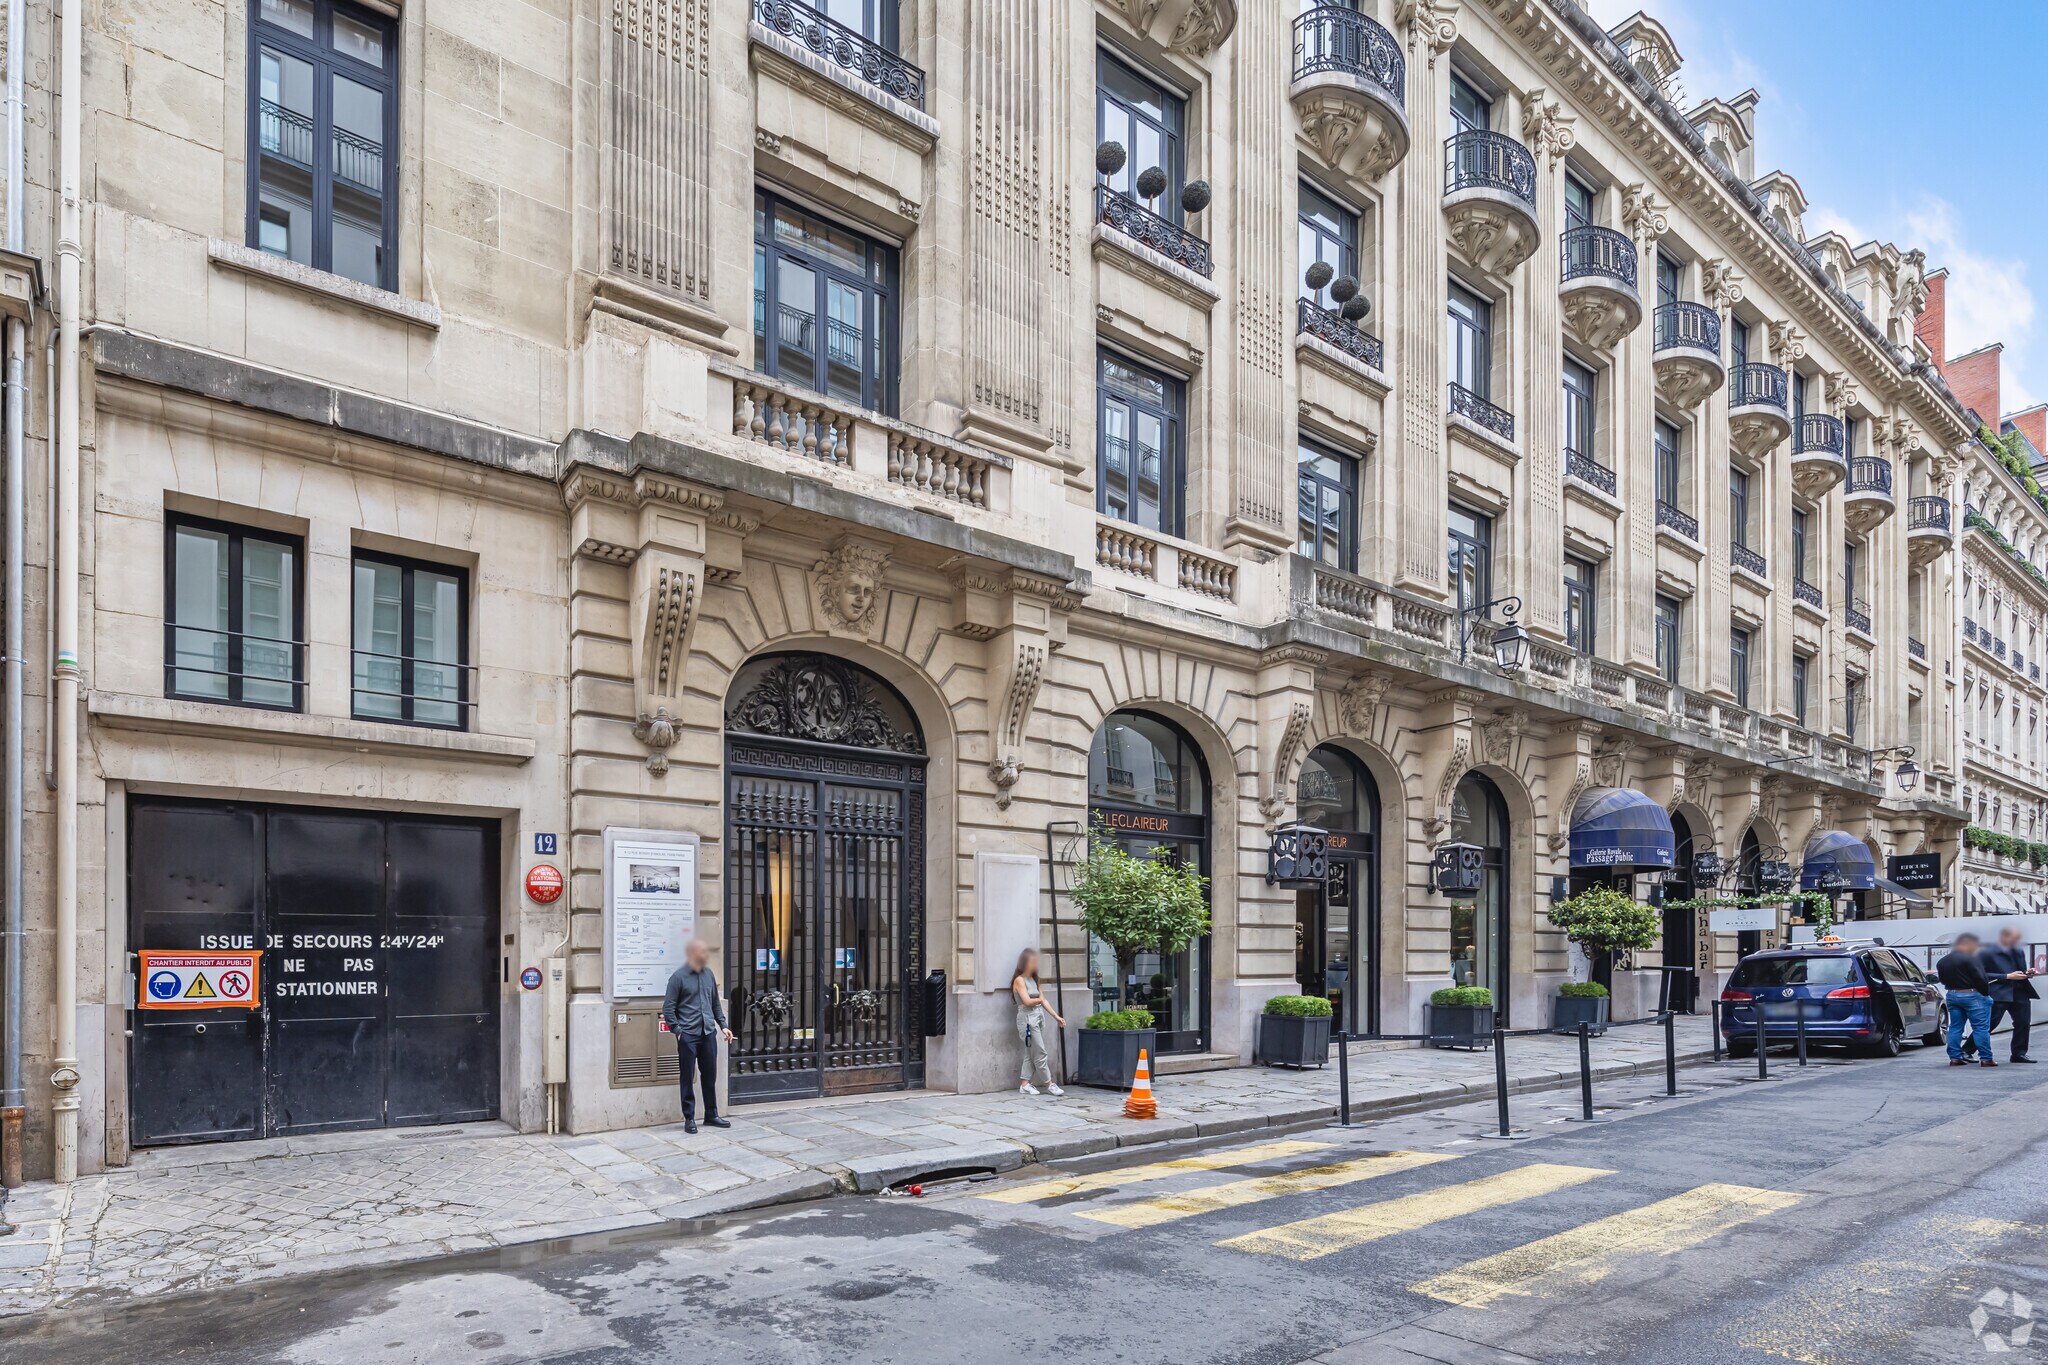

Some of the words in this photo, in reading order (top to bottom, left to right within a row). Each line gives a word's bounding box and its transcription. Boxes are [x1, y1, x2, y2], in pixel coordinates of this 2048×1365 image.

[1104, 813, 1169, 831] LECLAIREUR
[537, 835, 554, 852] 12
[1586, 854, 1613, 864] Passage
[1615, 852, 1634, 864] public
[1607, 848, 1622, 857] Royale
[200, 935, 253, 949] ISSUE
[266, 935, 284, 948] DE
[292, 934, 372, 948] SECOURS
[284, 959, 305, 972] NE
[344, 958, 374, 972] PAS
[276, 982, 378, 996] STATIONNER
